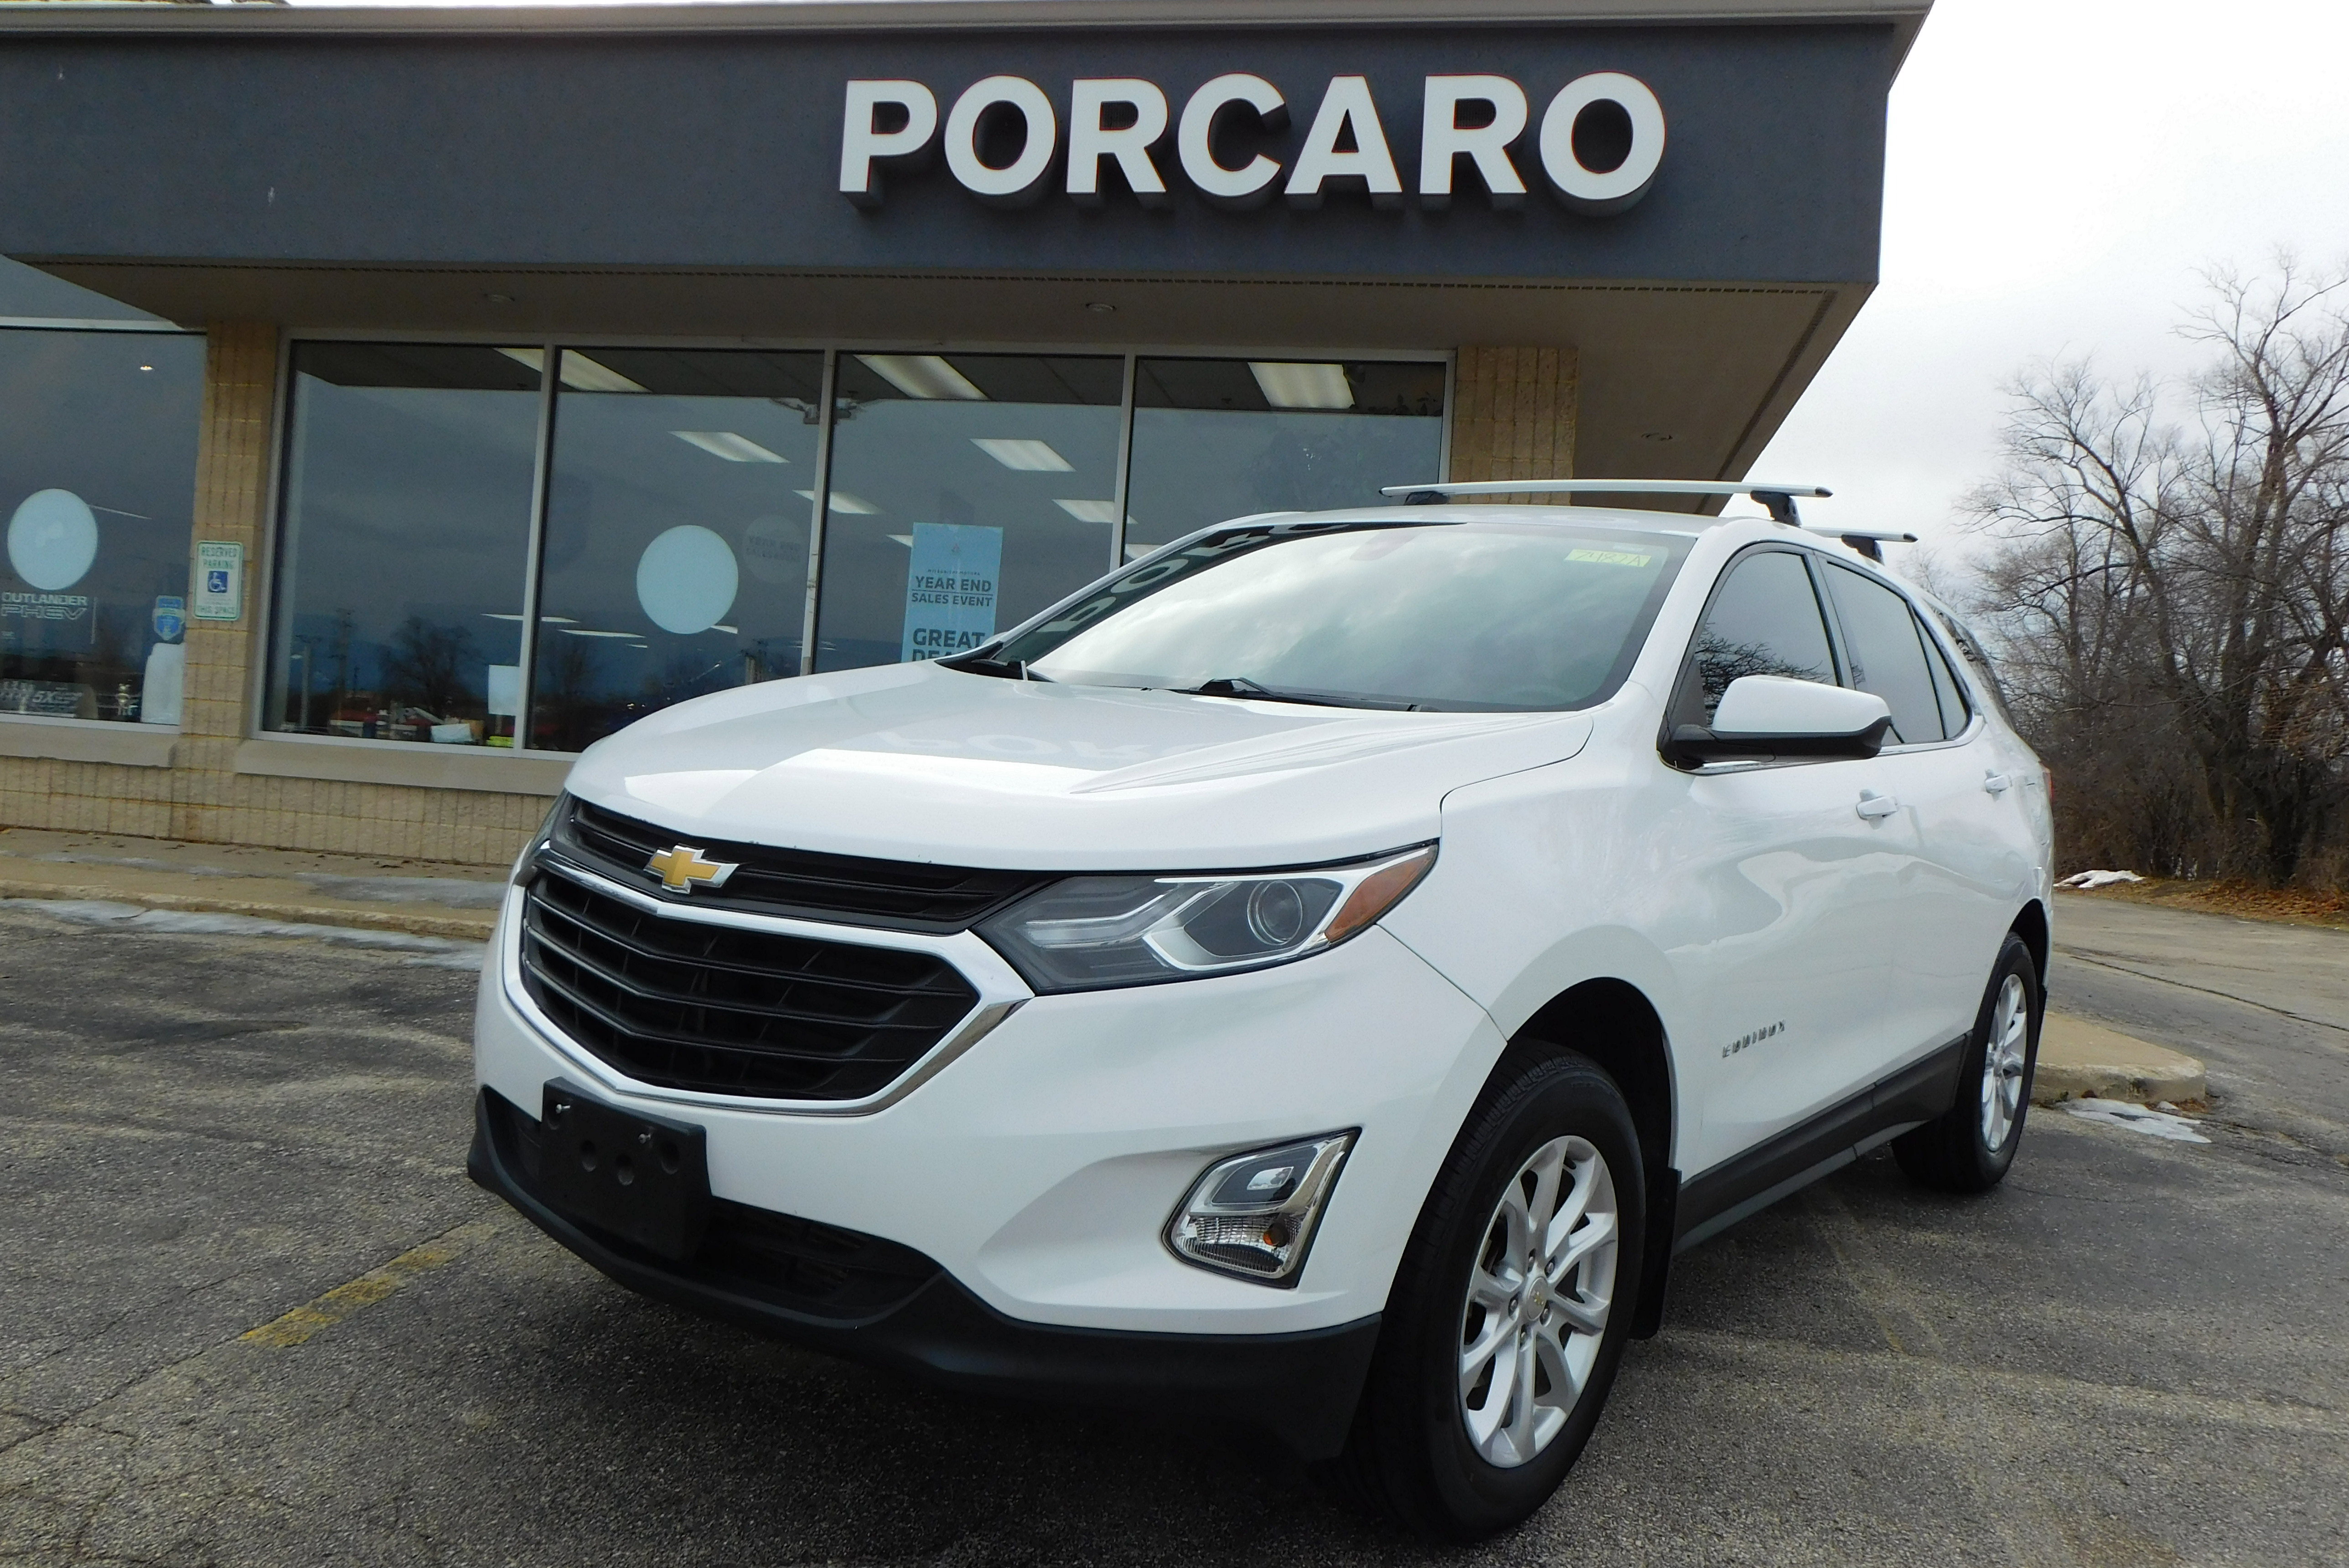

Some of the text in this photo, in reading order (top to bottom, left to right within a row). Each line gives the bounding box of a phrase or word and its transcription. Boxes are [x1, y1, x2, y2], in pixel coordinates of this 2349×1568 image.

[839, 72, 1666, 201] PORCARO
[202, 547, 237, 557] RESERVED
[203, 559, 233, 569] PARKING
[916, 576, 992, 592] YEAR END
[1, 591, 88, 606] OUTLANDER
[911, 593, 993, 607] SALES EVENT
[1, 603, 88, 620] PHEV
[913, 628, 985, 649] GREAT
